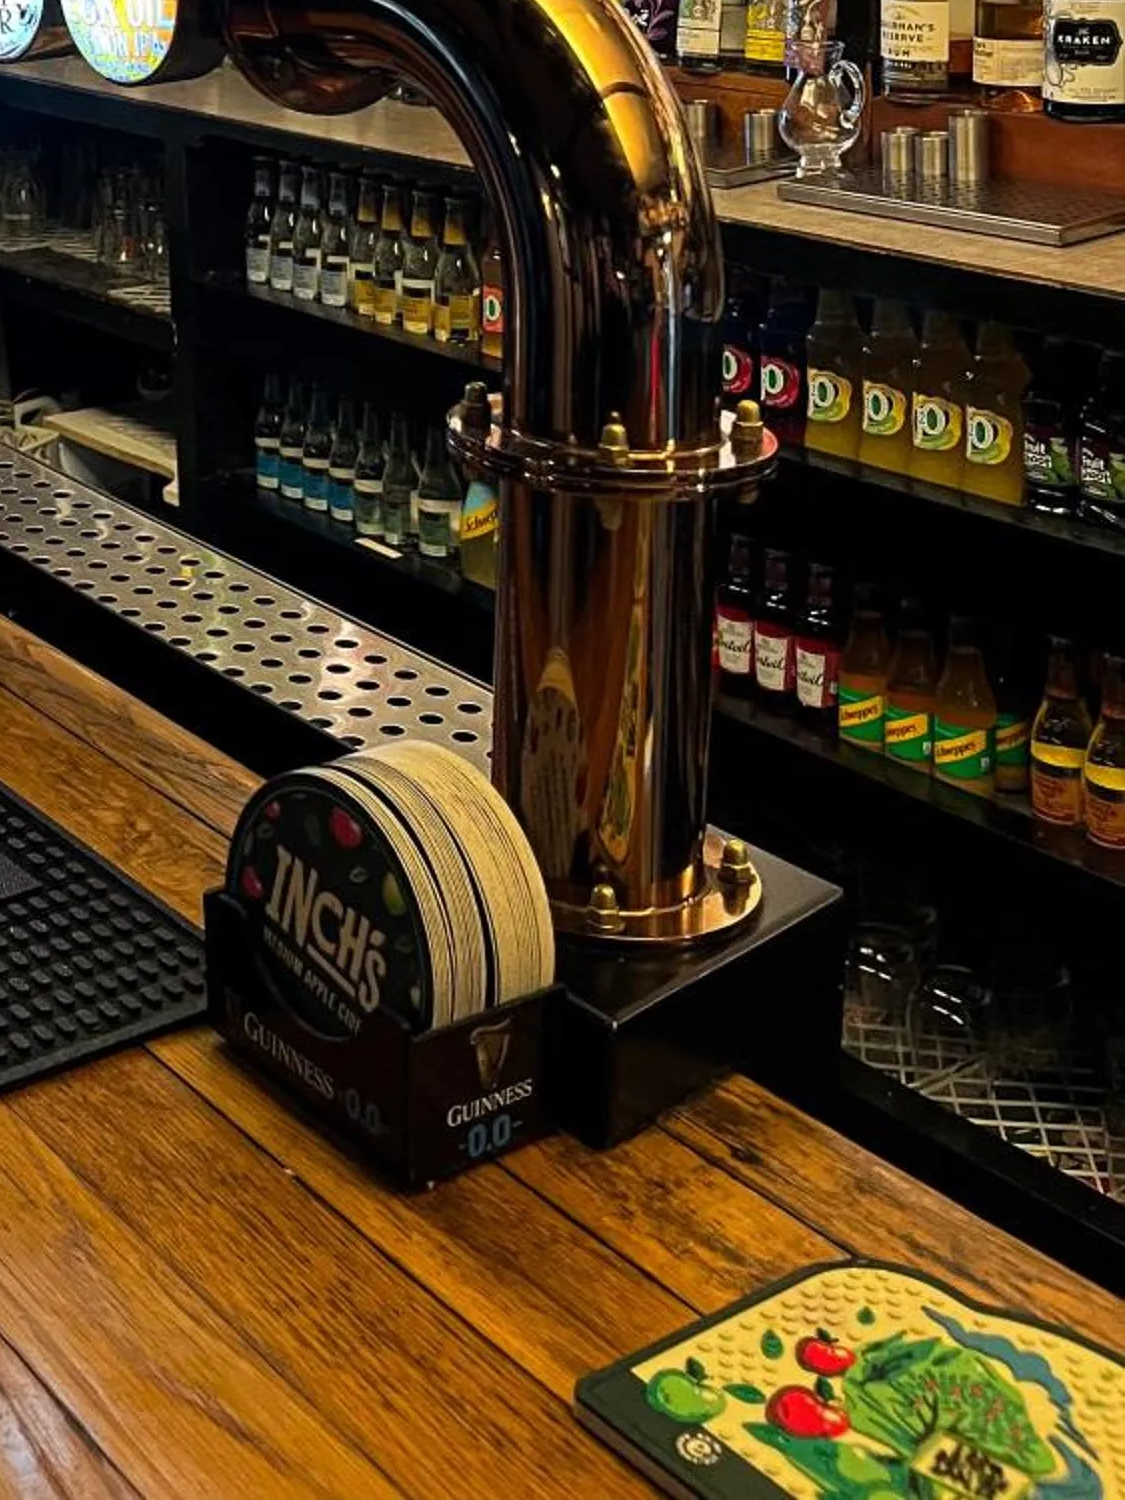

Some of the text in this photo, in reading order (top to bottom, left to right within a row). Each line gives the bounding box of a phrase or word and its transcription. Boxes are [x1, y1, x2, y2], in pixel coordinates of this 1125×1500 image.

[1057, 34, 1112, 46] KRAKEN
[243, 1012, 335, 1100] GUINNESS
[447, 1078, 535, 1128] GUINNESS
